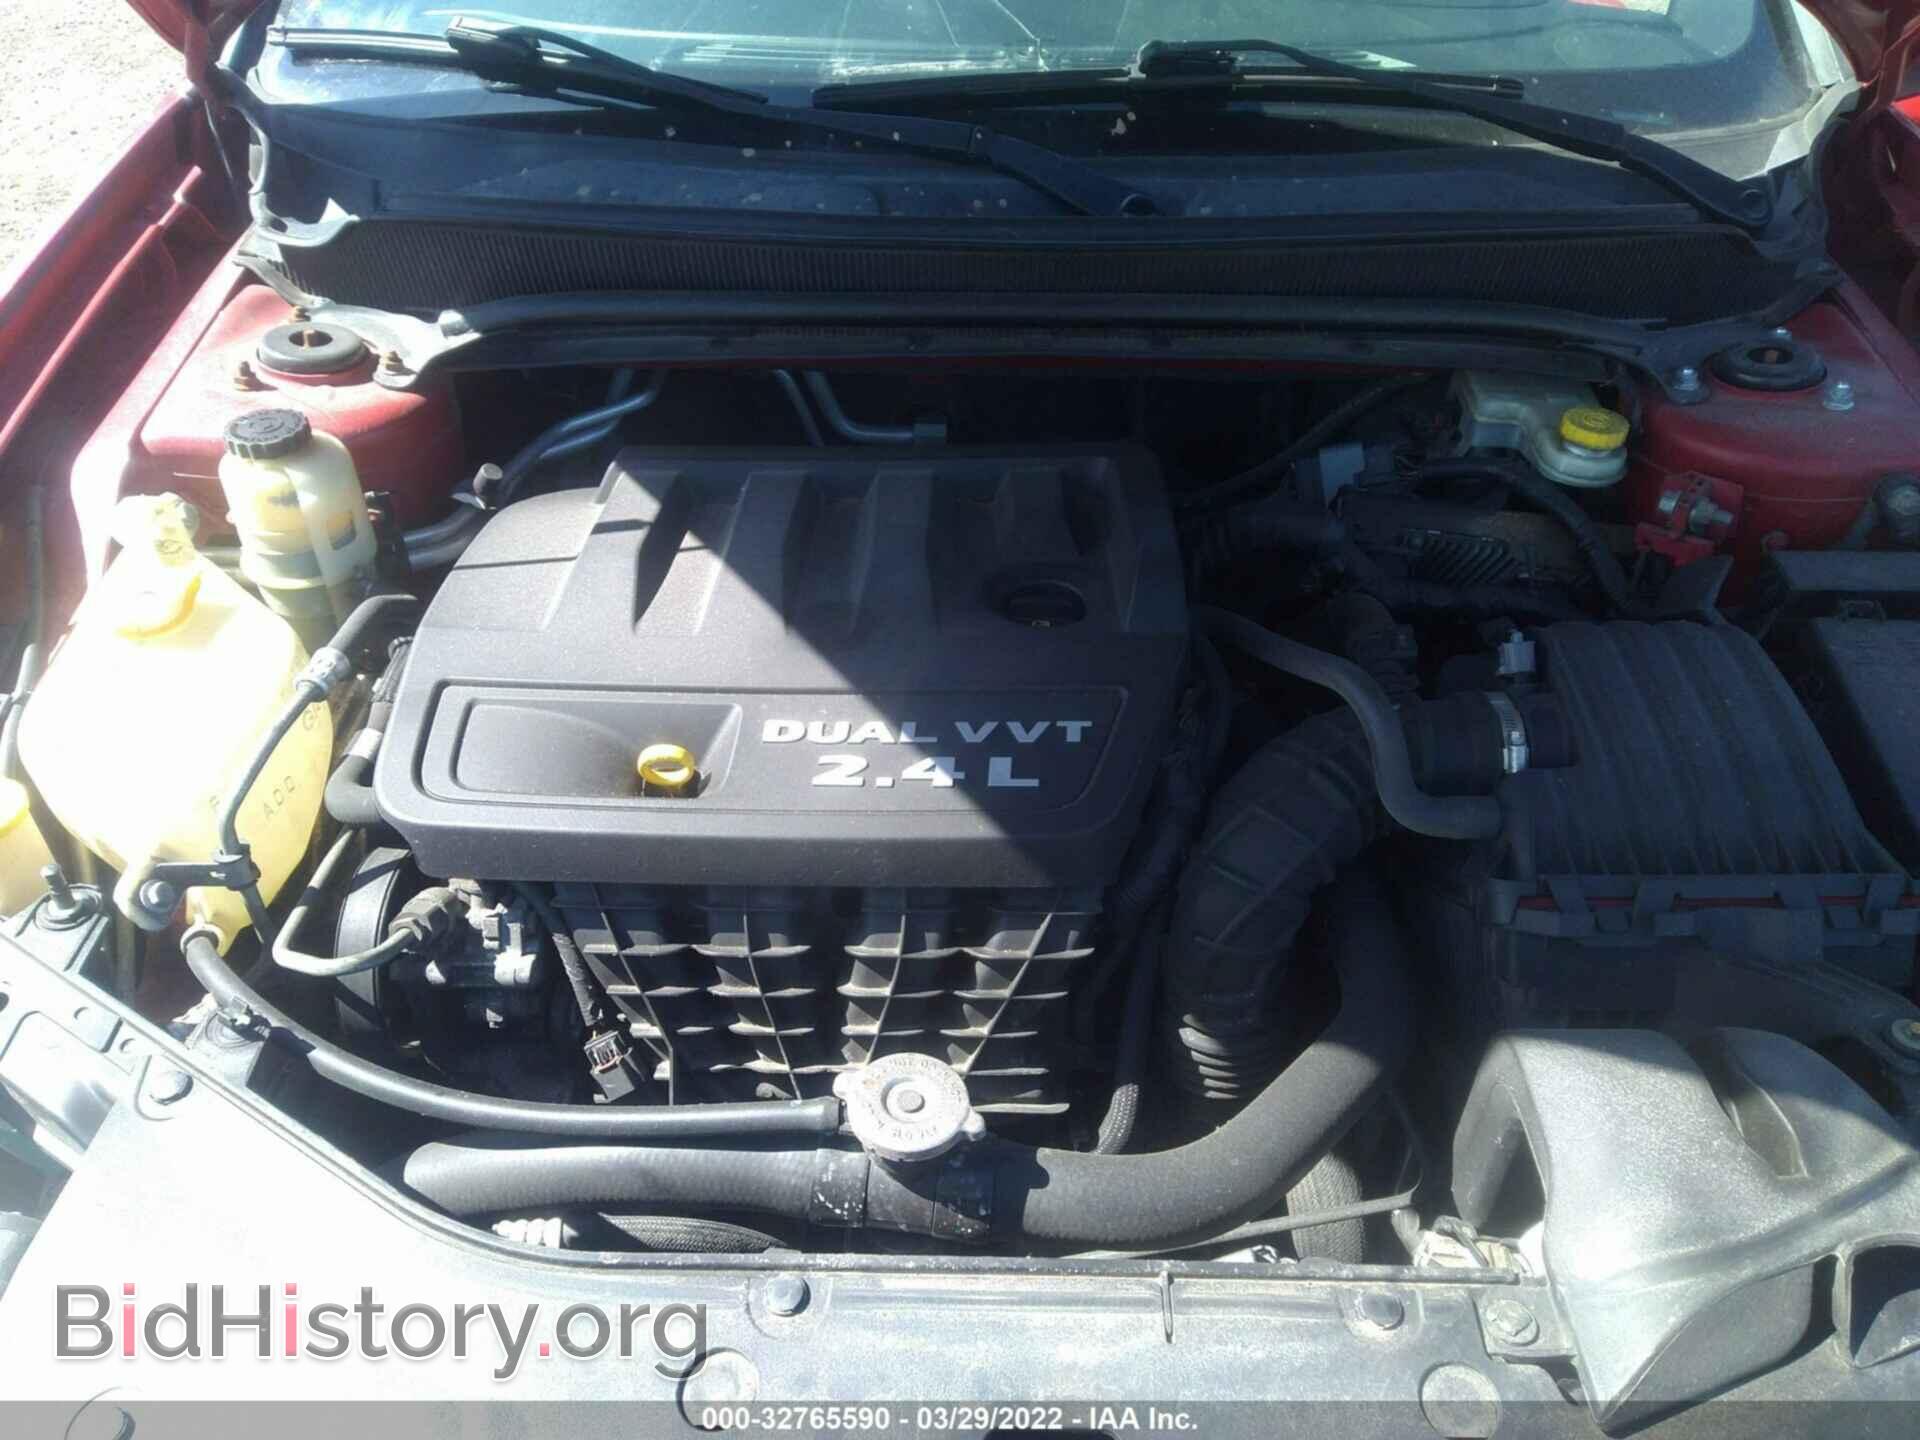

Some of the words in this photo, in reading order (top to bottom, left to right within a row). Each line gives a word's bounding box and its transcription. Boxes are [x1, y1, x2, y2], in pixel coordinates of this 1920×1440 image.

[762, 719, 938, 744] DUAL
[956, 721, 1092, 743] VVT
[812, 755, 966, 788] 2.4
[988, 757, 1040, 787] L
